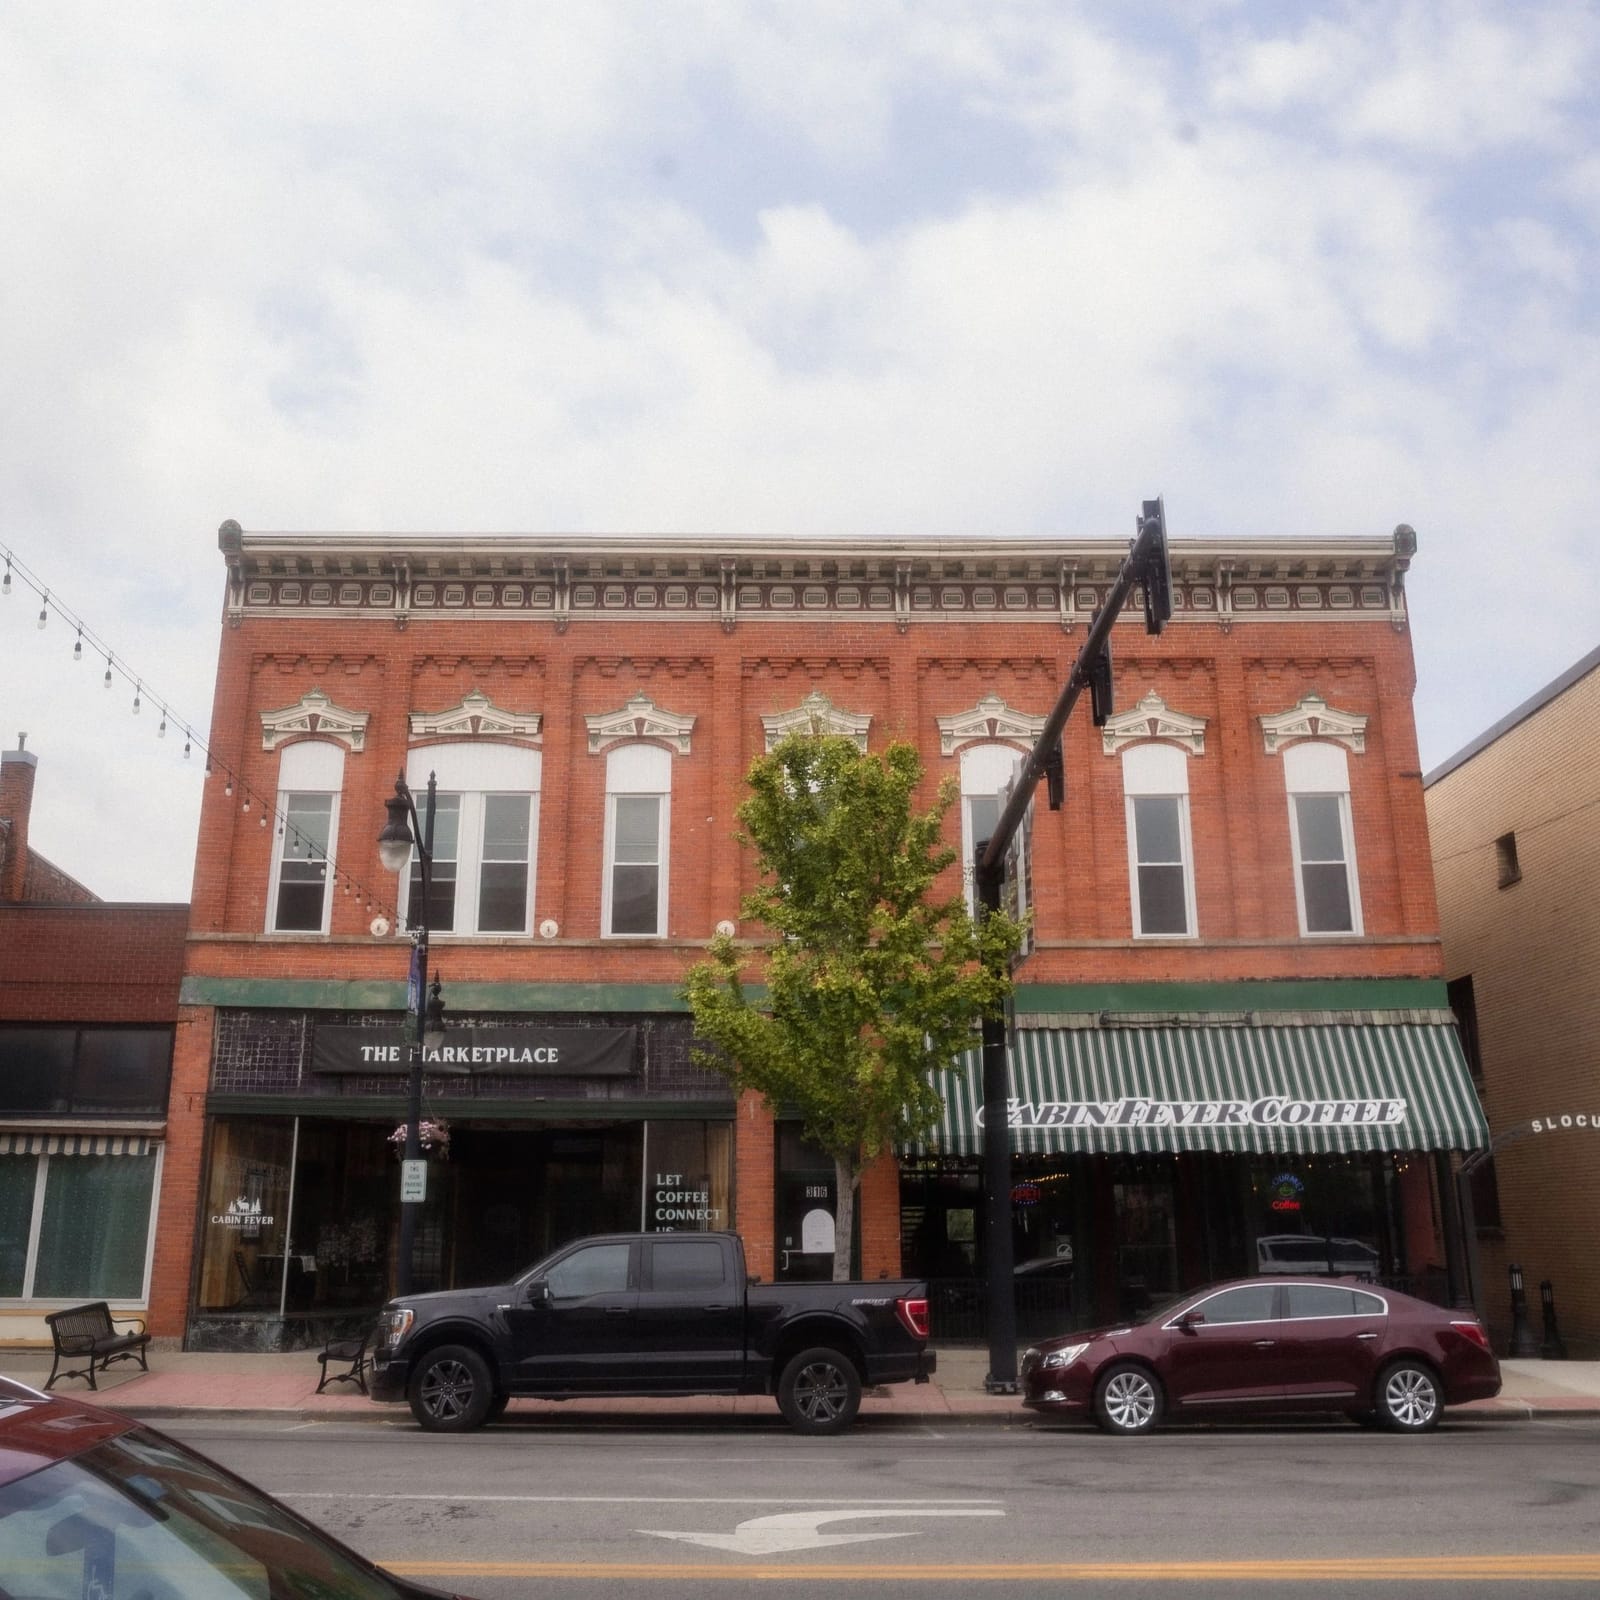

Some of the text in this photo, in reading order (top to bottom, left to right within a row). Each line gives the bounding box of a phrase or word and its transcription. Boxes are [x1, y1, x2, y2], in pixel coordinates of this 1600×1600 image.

[360, 1046, 400, 1062] THE
[1117, 1097, 1251, 1127] FEVER
[1247, 1096, 1408, 1126] COFFEE
[656, 1173, 683, 1186] LET
[656, 1190, 709, 1203] COFFEE
[211, 1215, 274, 1225] CABIN FEVER
[655, 1208, 721, 1221] CONNECT
